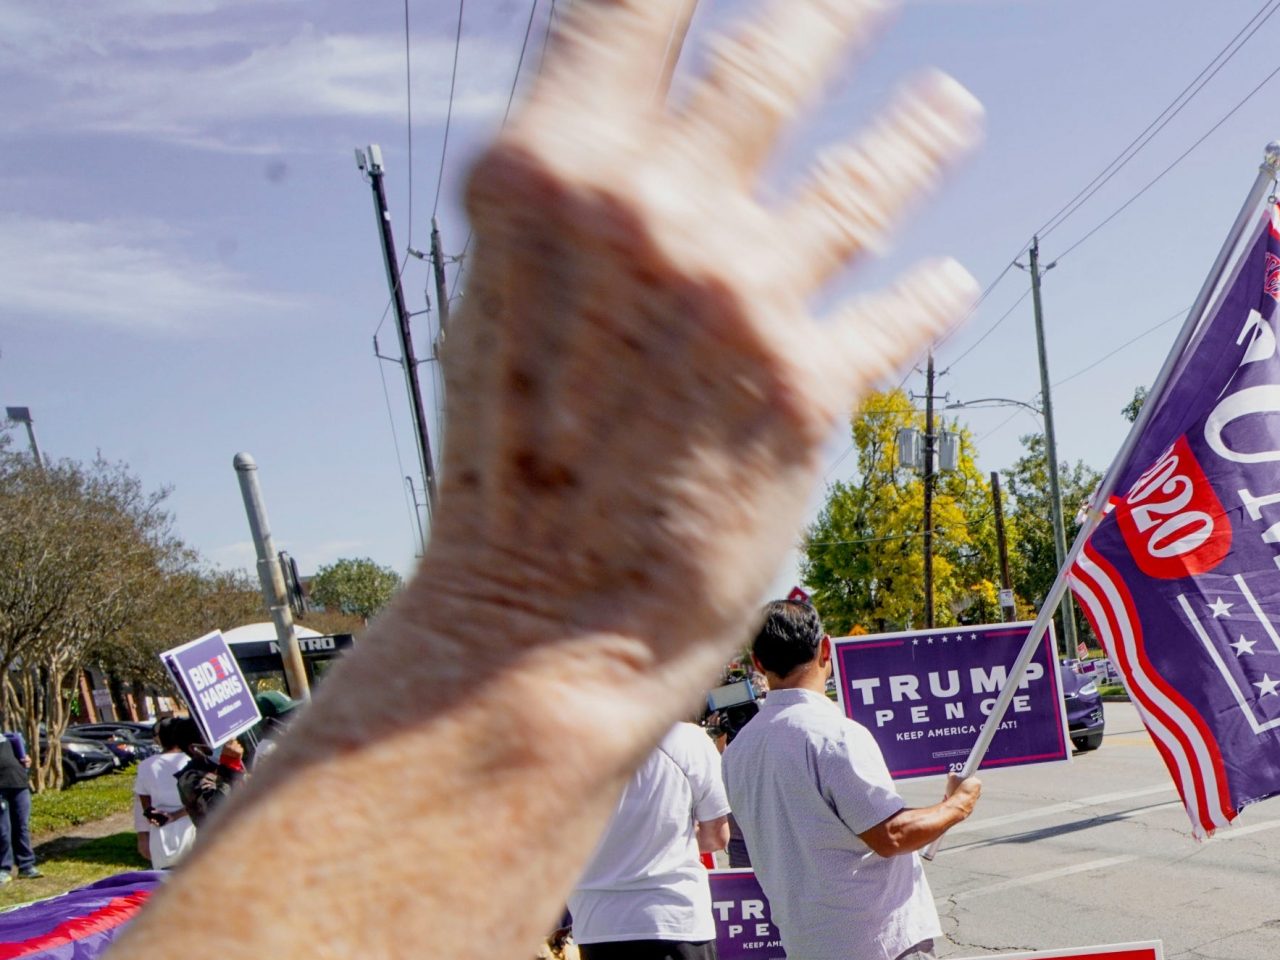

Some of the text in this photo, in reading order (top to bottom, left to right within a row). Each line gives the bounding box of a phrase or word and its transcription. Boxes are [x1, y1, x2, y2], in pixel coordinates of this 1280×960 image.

[269, 637, 336, 655] MTRO
[188, 652, 234, 692] BIDEN
[852, 662, 1044, 705] TRUMP
[200, 675, 243, 711] HARRIS
[875, 695, 1032, 728] PENCE
[896, 729, 924, 742] KEEP
[927, 727, 976, 738] AMERICA
[742, 942, 765, 950] KEEP
